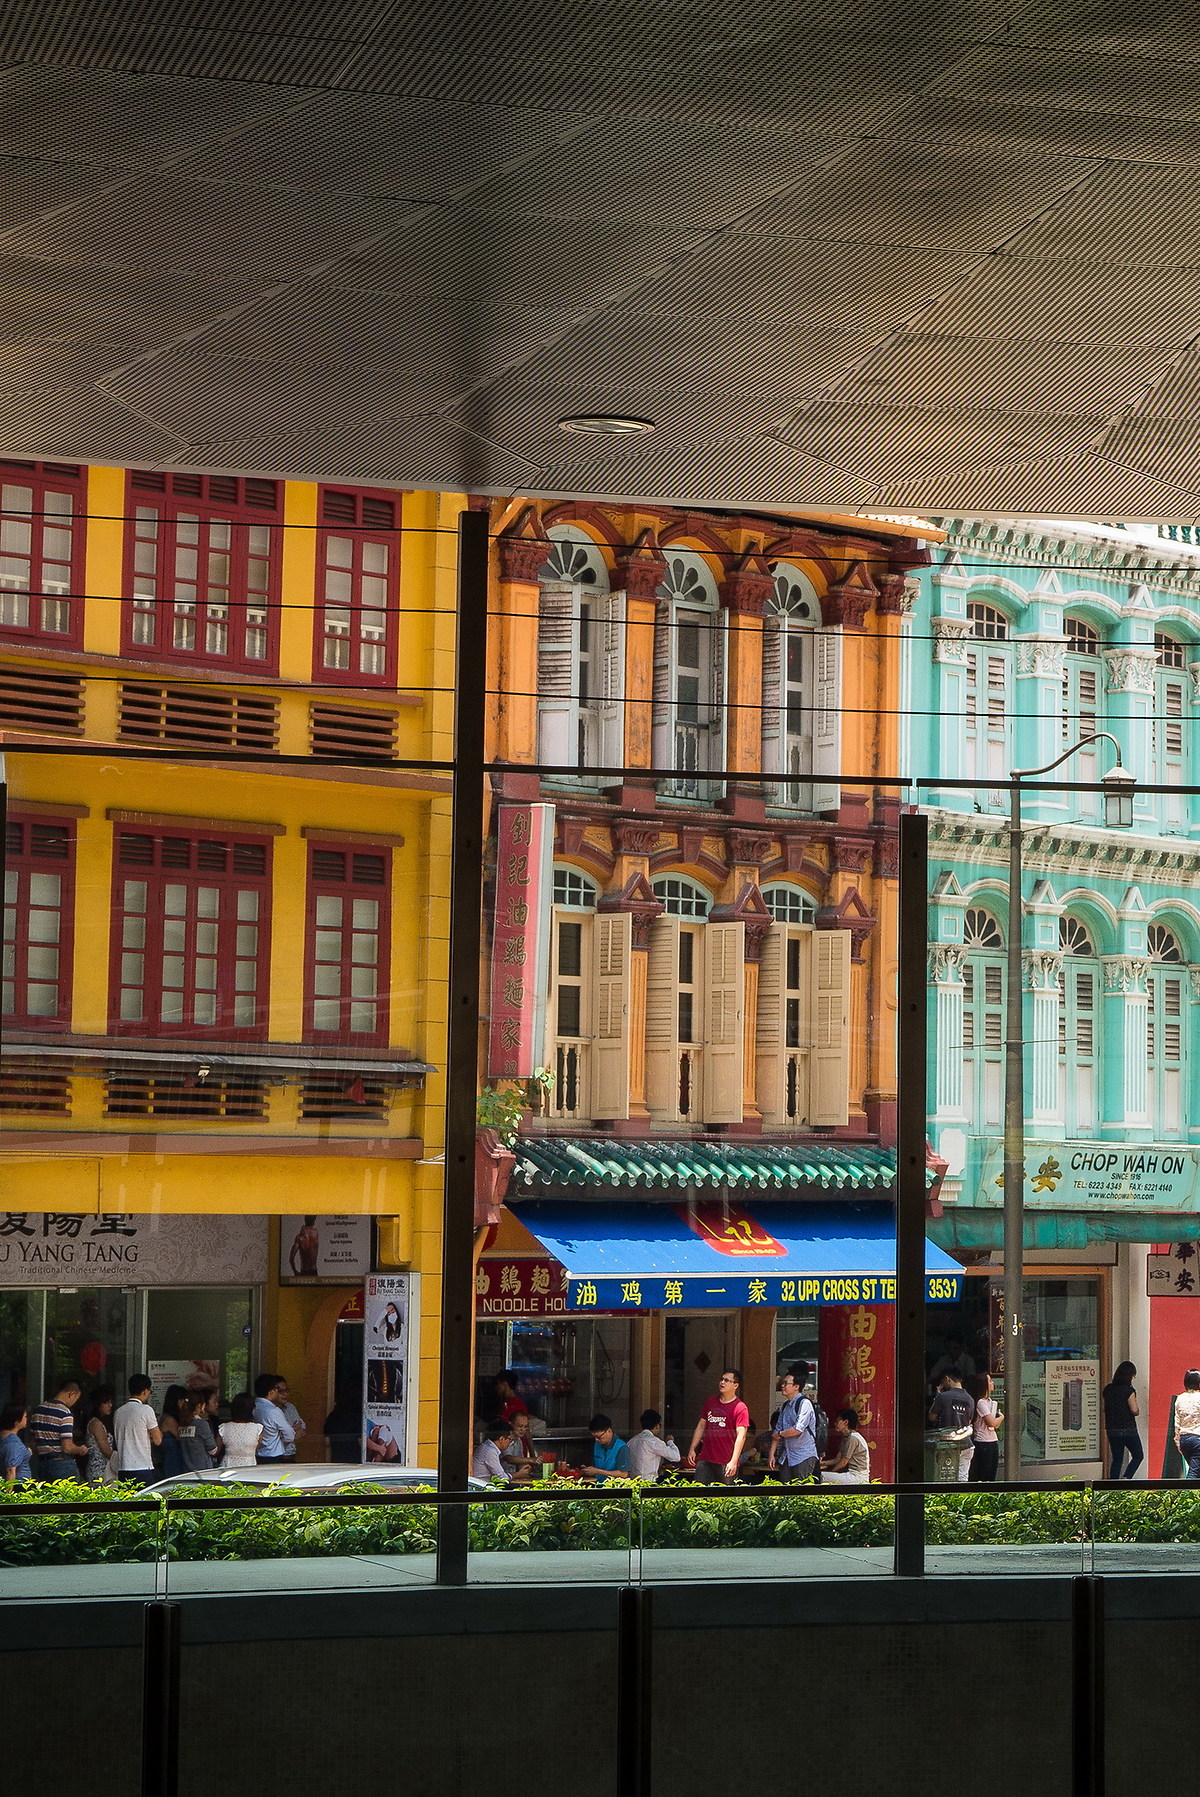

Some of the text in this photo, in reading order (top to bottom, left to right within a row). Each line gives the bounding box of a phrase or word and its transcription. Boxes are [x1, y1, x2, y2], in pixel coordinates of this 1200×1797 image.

[1070, 1152, 1185, 1175] CHOP WAH ON
[1111, 1172, 1128, 1180] SINCE
[1088, 1181, 1104, 1190] 6223
[1105, 1182, 1122, 1190] 4349
[1144, 1183, 1158, 1191] 6221
[1159, 1184, 1172, 1192] 4140
[1088, 1191, 1154, 1200] www.chopwahon.com
[18, 1242, 74, 1262] YANG
[82, 1242, 139, 1262] TANG
[20, 1266, 62, 1274] Traditional
[101, 1266, 136, 1274] Medicine
[576, 1279, 767, 1306] 油鸡第一家
[781, 1281, 795, 1301] 32
[798, 1280, 820, 1301] UPP
[823, 1279, 860, 1300] CROSS
[862, 1279, 877, 1300] ST
[929, 1279, 957, 1298] 3531
[483, 1298, 538, 1312] NOODLE
[1012, 1314, 1018, 1336] 13
